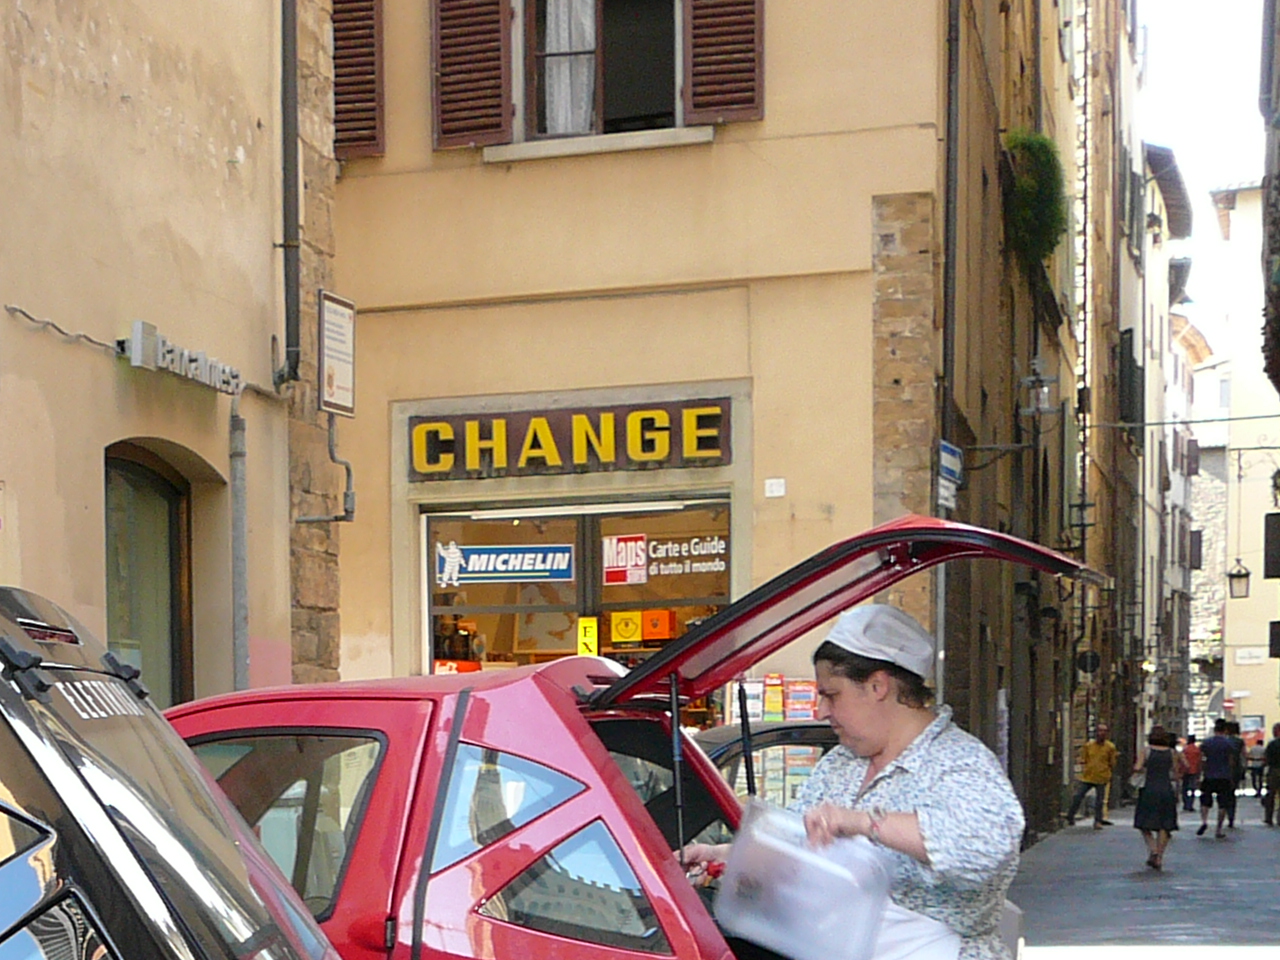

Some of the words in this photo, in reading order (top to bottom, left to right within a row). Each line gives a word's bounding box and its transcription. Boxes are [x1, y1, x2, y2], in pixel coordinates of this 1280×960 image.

[411, 406, 723, 474] CHANGE
[603, 536, 647, 570] Maps
[648, 541, 680, 558] Carte
[681, 542, 689, 556] e
[690, 535, 726, 555] Guide
[467, 552, 570, 572] MICHELIN
[648, 561, 659, 575] di
[660, 563, 683, 575] tutto
[684, 560, 691, 573] il
[691, 558, 726, 572] mondo
